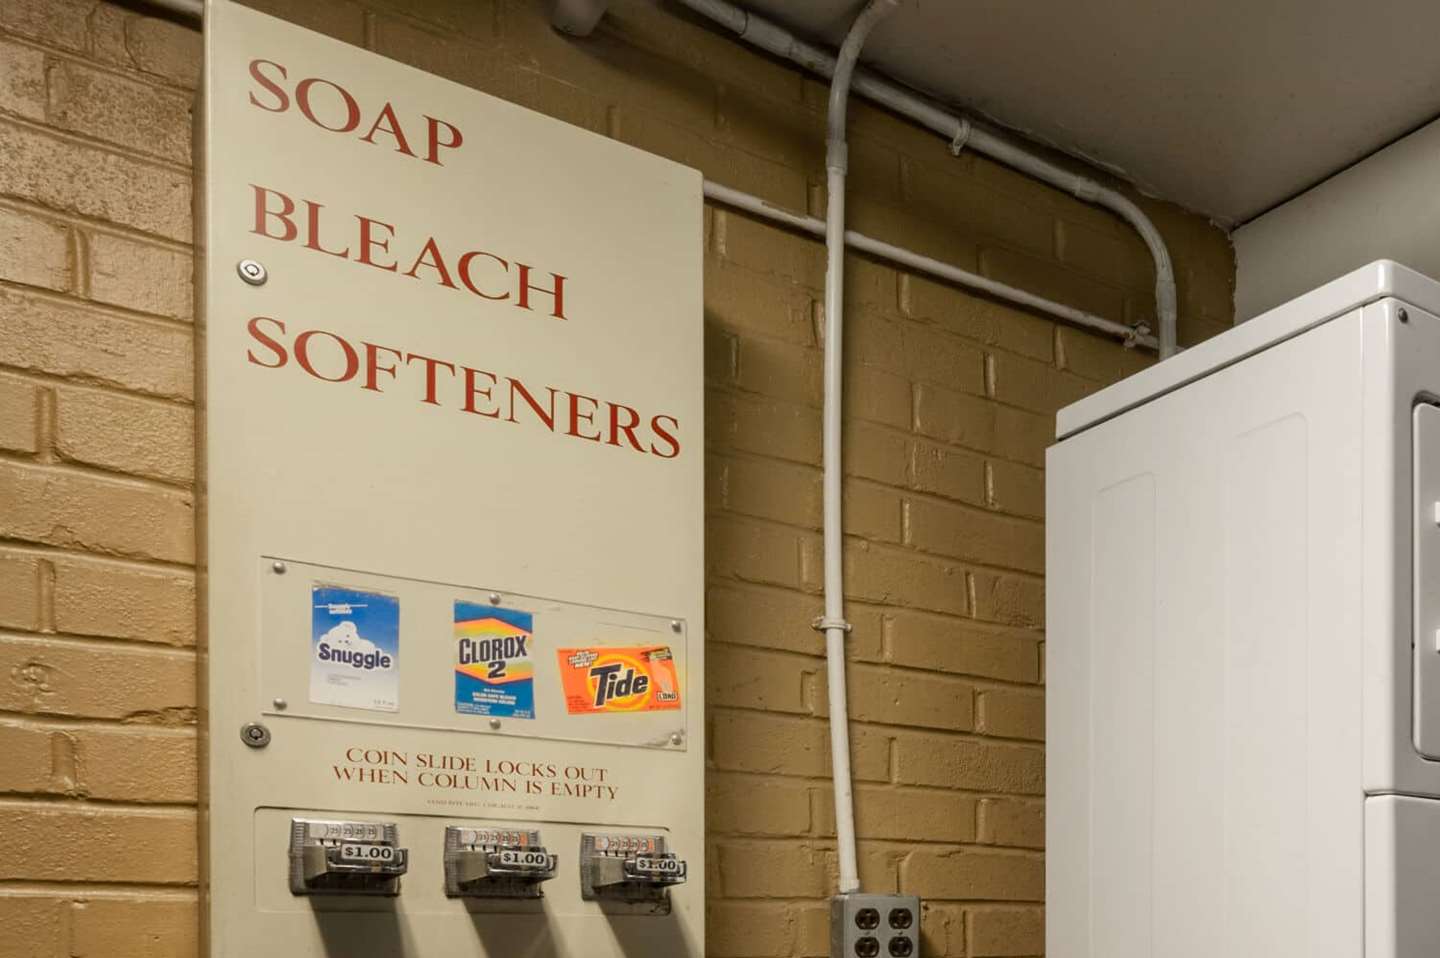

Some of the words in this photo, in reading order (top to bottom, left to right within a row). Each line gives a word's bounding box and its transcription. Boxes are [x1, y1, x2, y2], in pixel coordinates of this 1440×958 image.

[248, 59, 463, 167] SOAP
[248, 184, 568, 321] BLEACH
[247, 316, 681, 459] SOFTENERS
[319, 643, 391, 669] Snuggle
[459, 635, 527, 664] CLOROX
[487, 661, 506, 678] 2
[590, 664, 648, 706] Tide
[346, 747, 408, 766] COIN
[416, 753, 477, 772] SLIDE
[485, 760, 557, 778] LOCKS
[564, 766, 608, 782] OUT
[333, 765, 408, 784] WHEN
[418, 772, 516, 792] COLUMN
[526, 780, 542, 794] IS
[551, 782, 618, 800] EMPTY
[345, 846, 392, 859] $1.00
[503, 853, 544, 865] $1.00
[639, 860, 676, 871] $1.00
